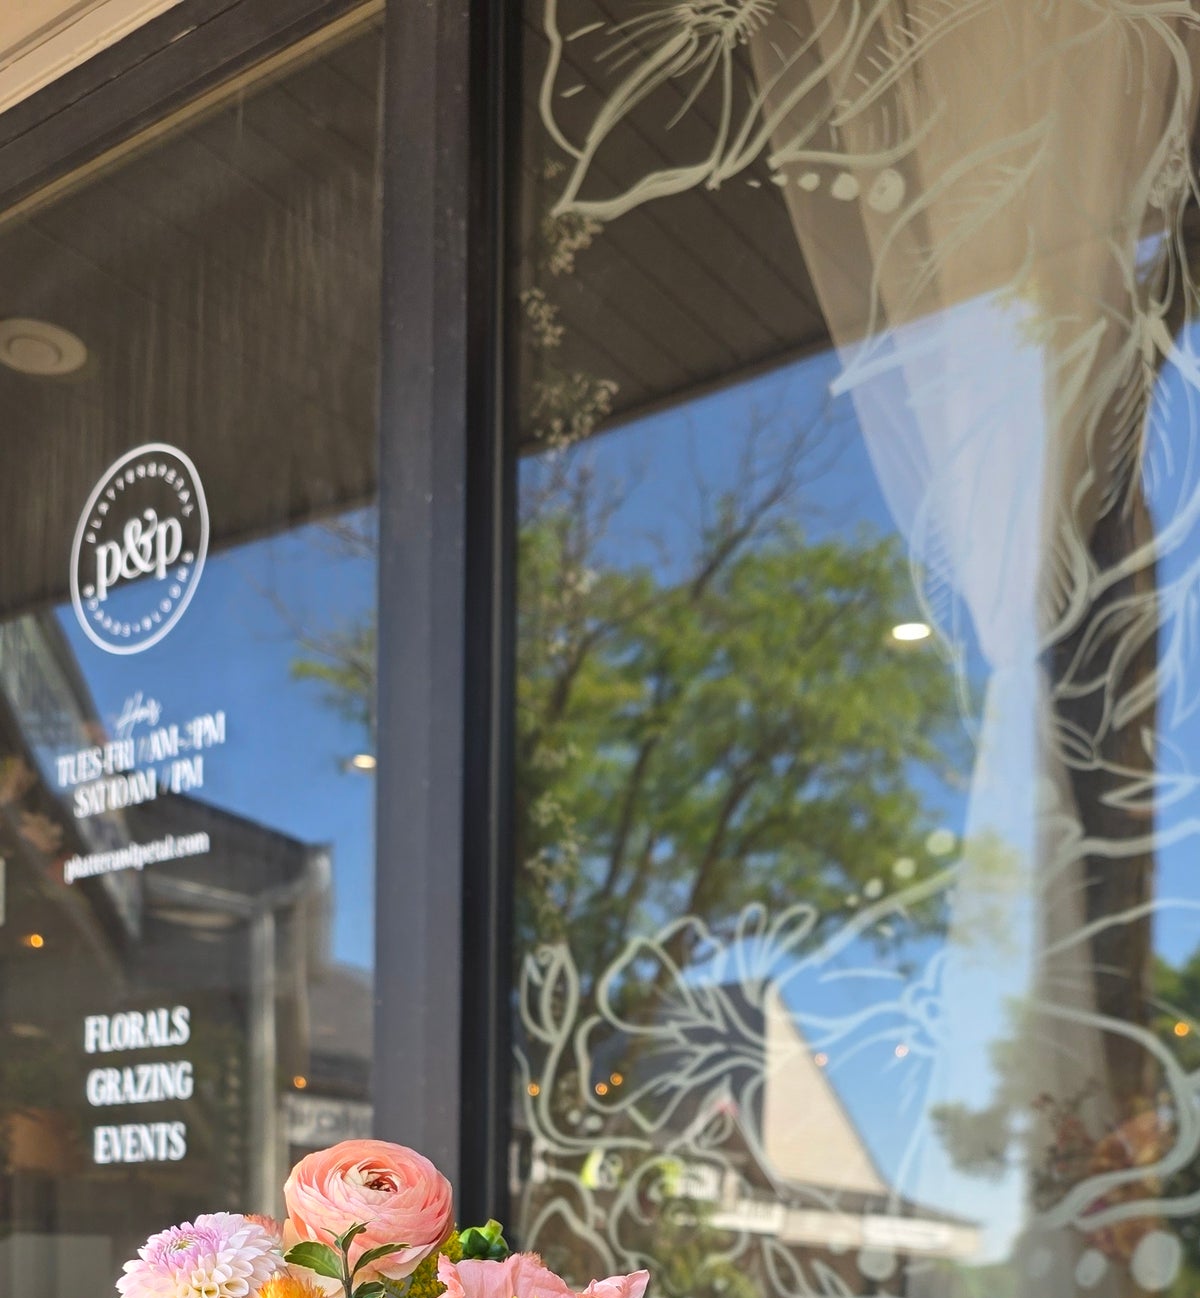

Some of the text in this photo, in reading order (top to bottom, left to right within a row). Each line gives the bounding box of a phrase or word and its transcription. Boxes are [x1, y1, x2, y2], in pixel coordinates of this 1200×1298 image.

[96, 507, 183, 601] p&p
[84, 1005, 190, 1054] FLORALS
[86, 1060, 194, 1107] GRAZING
[94, 1121, 187, 1164] EVENTS
